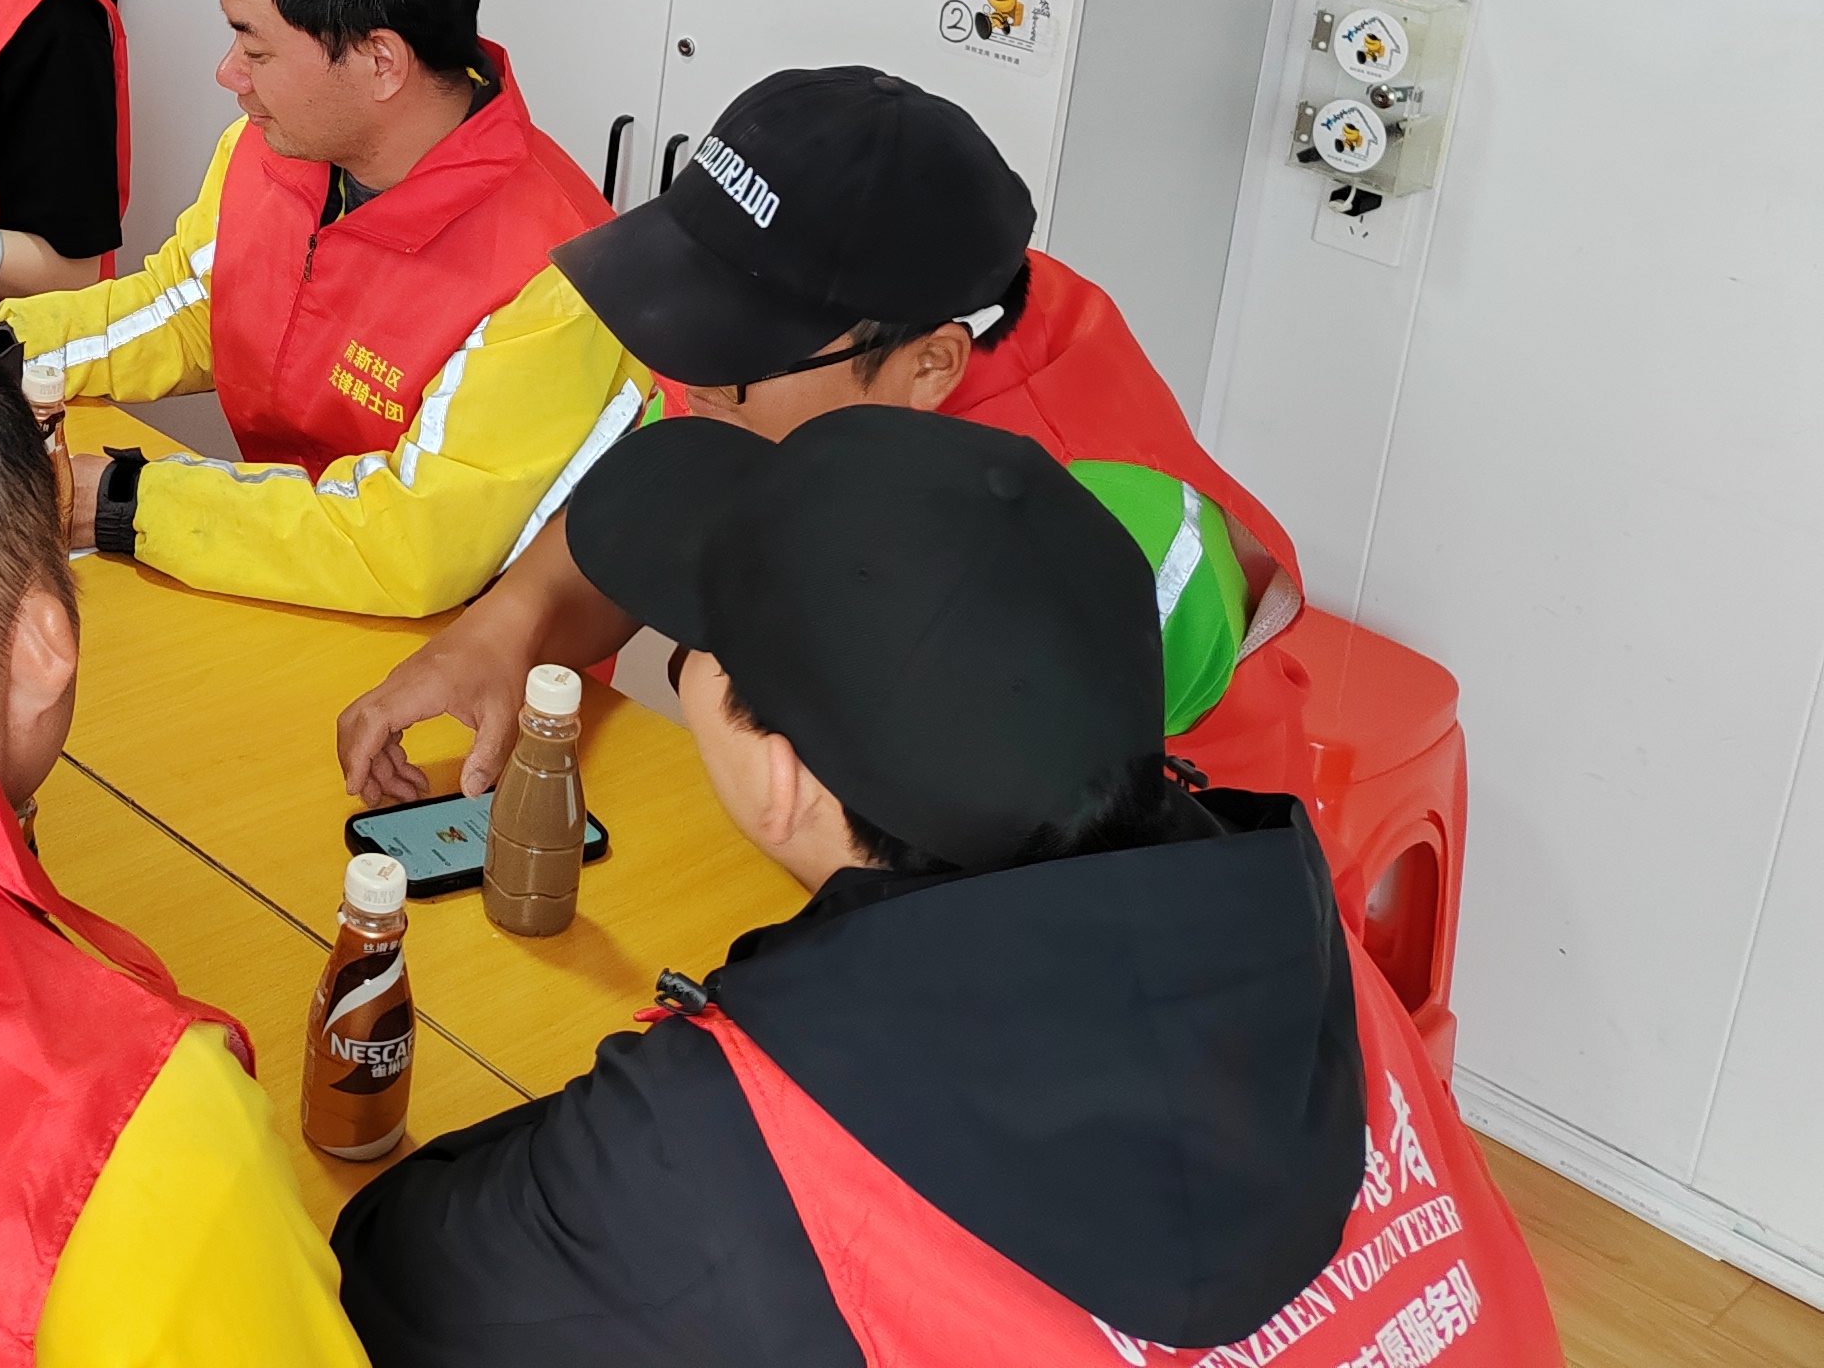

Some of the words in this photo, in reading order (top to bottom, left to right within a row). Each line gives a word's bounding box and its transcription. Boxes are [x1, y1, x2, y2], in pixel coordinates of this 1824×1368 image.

[693, 135, 781, 229] COLORADO
[331, 1027, 415, 1065] NESCAF
[1323, 1194, 1462, 1300] VOLUNTEER
